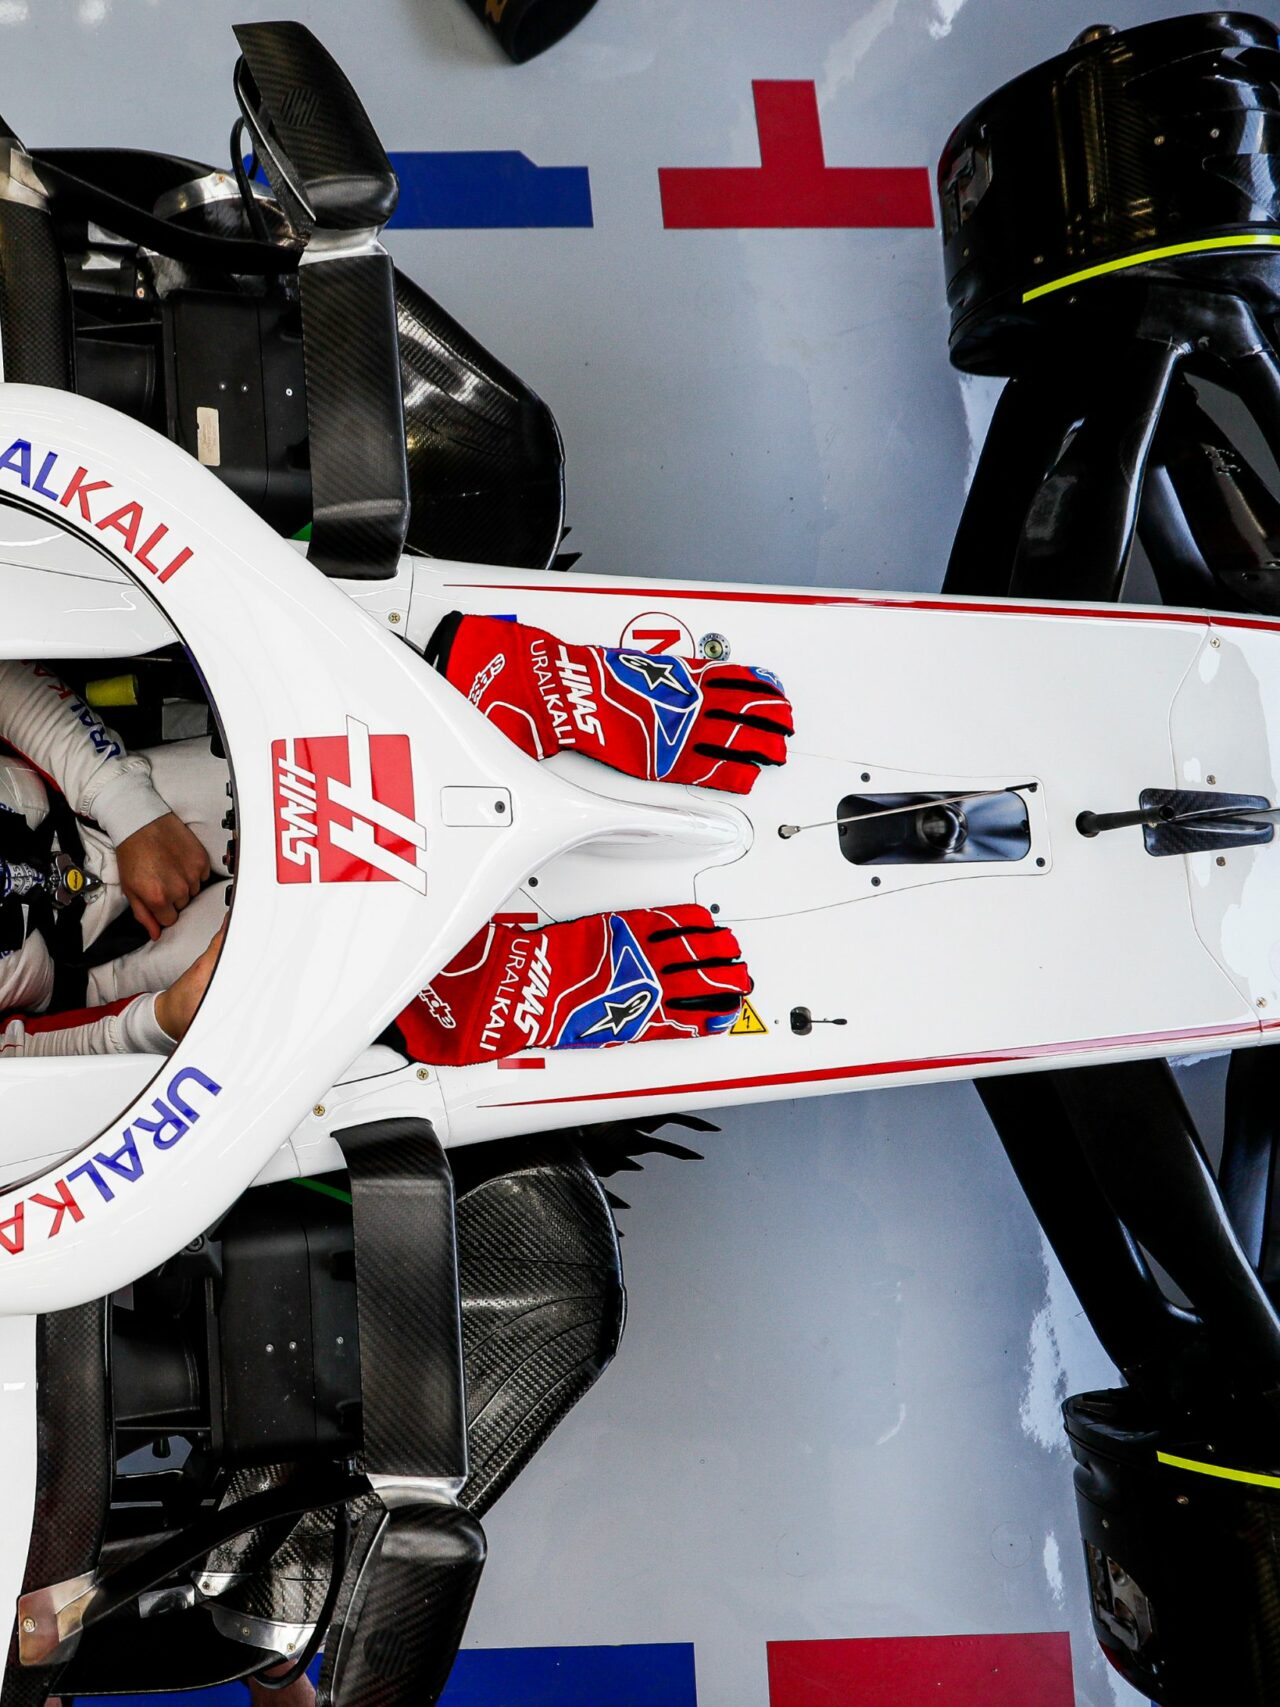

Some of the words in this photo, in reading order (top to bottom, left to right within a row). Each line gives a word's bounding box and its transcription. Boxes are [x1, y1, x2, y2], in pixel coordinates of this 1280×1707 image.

[529, 639, 576, 746] URALKALI
[555, 643, 606, 747] HAAS
[277, 738, 321, 884] HAAS
[478, 938, 531, 1052] URALKALI
[514, 933, 552, 1048] HAAS
